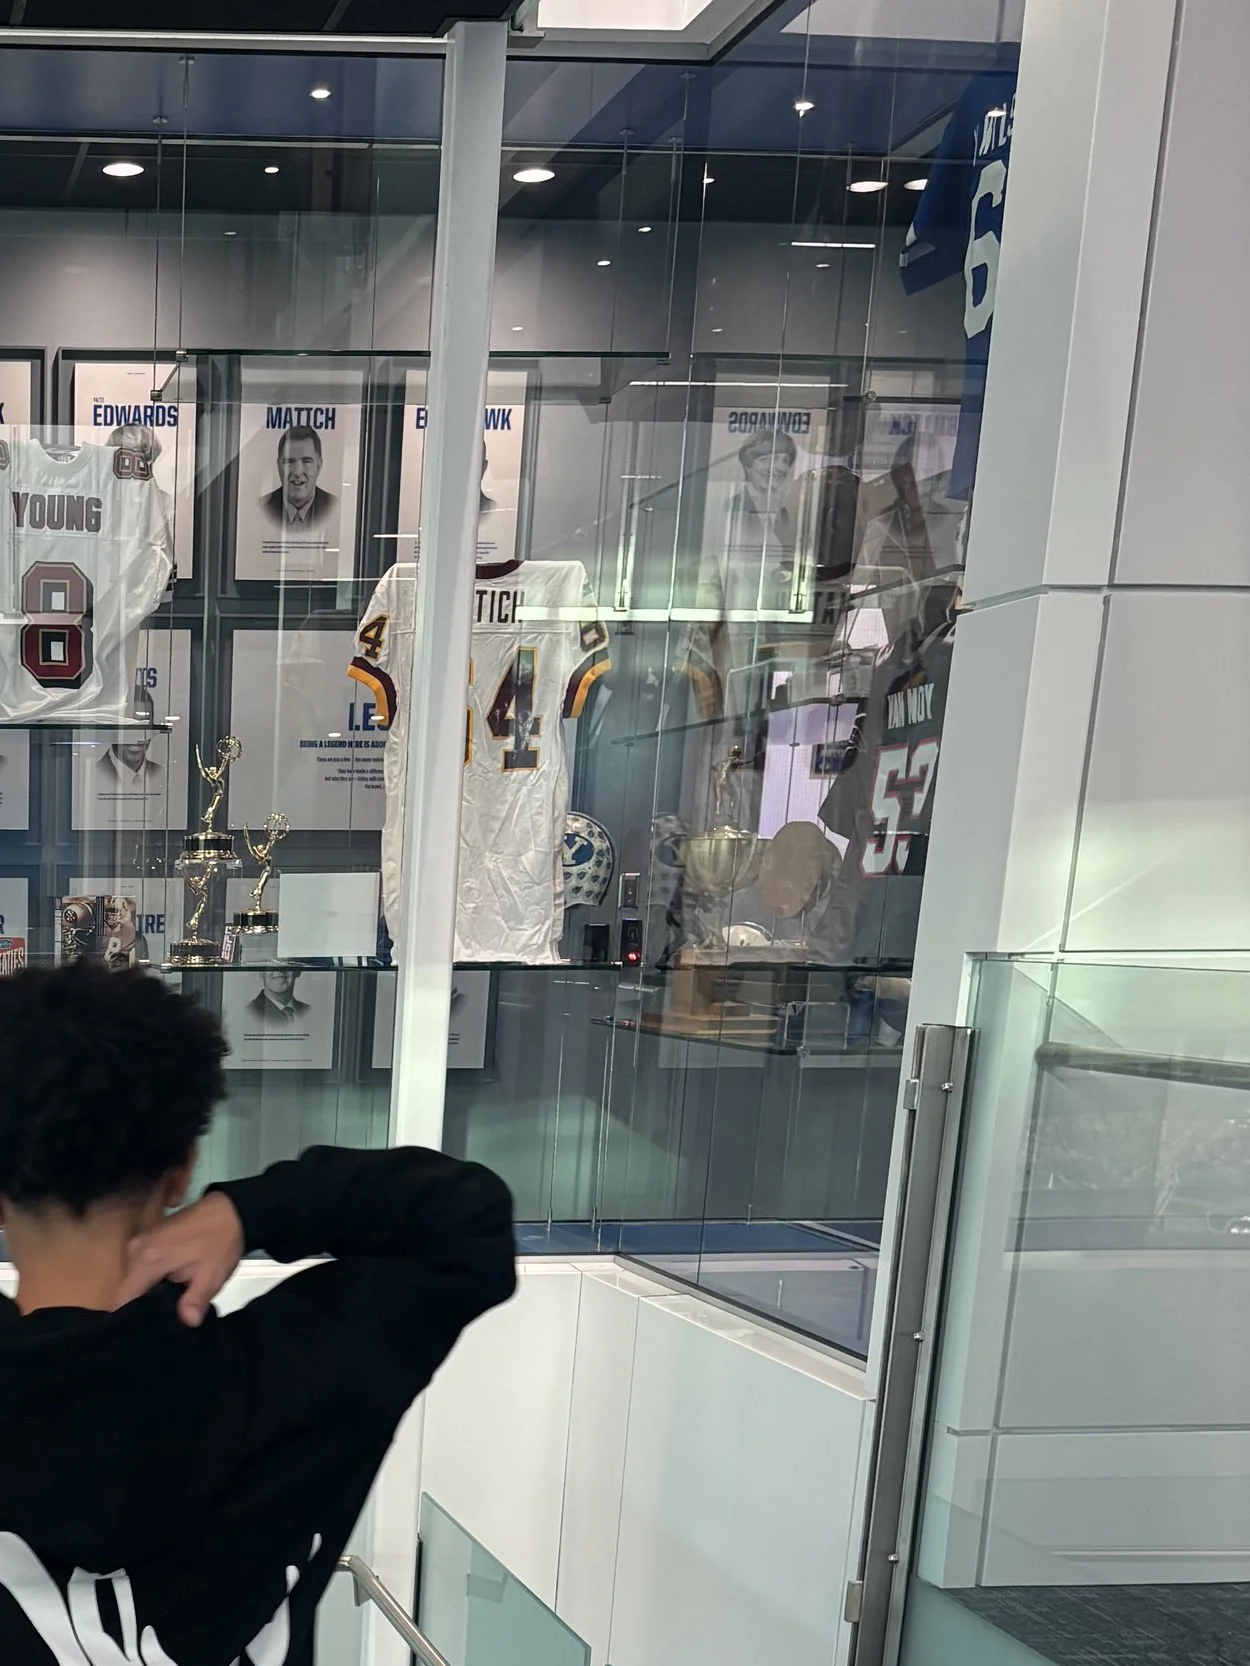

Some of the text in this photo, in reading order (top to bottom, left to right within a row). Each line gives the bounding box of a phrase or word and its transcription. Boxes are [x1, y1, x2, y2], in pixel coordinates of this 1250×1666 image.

[92, 404, 178, 427] EDWARDS
[11, 491, 102, 532] YOUNG
[21, 561, 93, 690] 8
[359, 614, 390, 659] 4
[887, 691, 905, 729] VAN
[861, 736, 941, 878] 53
